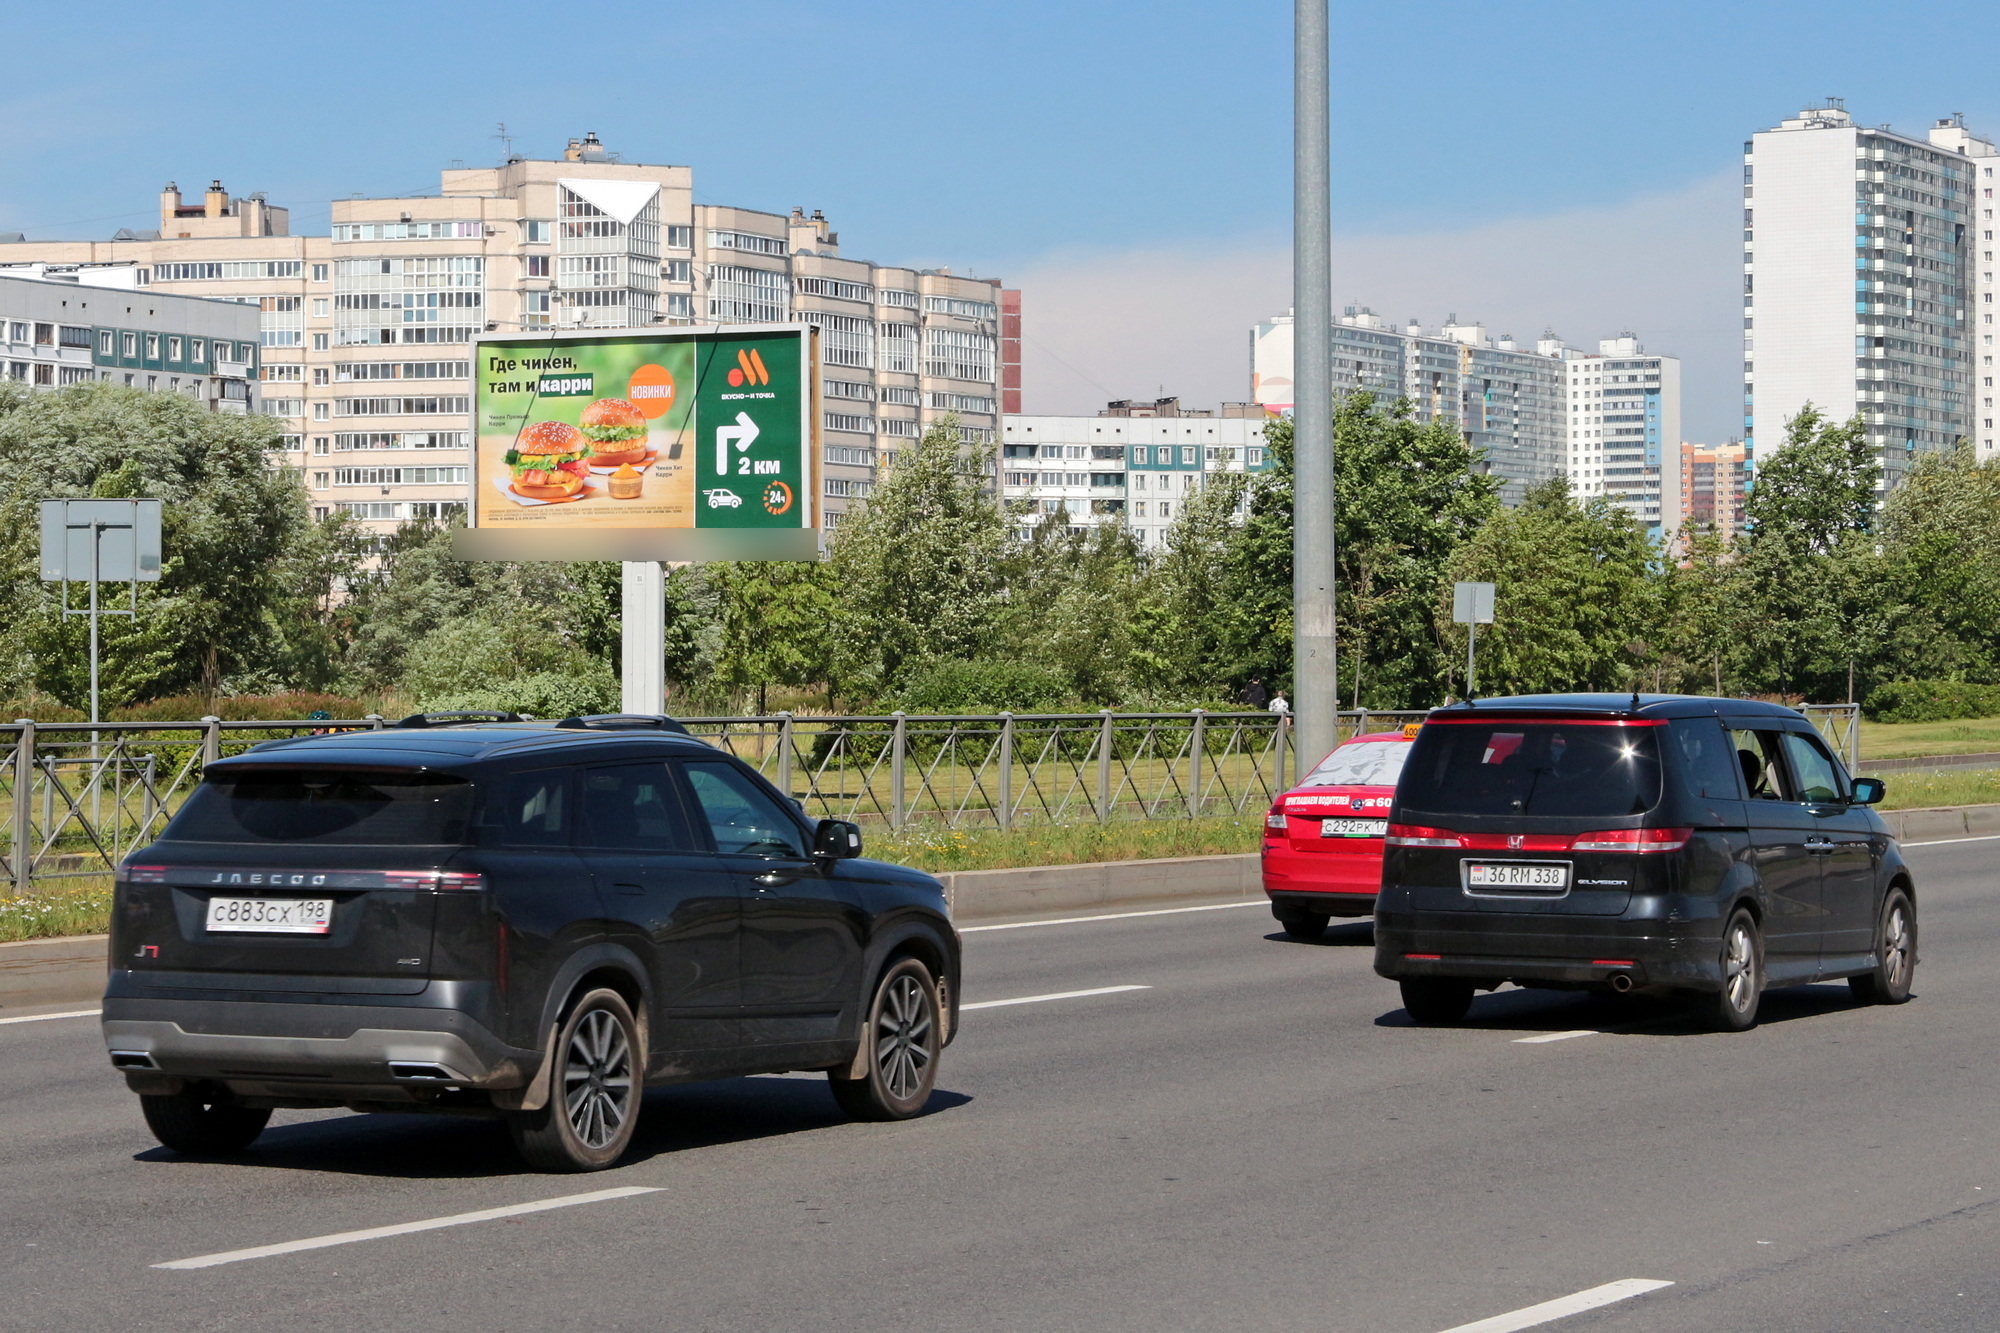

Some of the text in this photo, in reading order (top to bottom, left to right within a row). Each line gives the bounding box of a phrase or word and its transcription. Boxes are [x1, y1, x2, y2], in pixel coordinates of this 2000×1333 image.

[489, 357, 578, 374] Где чикен,
[488, 378, 592, 395] там и карри
[631, 385, 671, 399] НОВИНКИ
[738, 457, 750, 474] 2
[1310, 649, 1316, 658] 2
[1404, 727, 1421, 736] 600
[1318, 795, 1350, 806] ВОДИТЕЛЕЙ
[1489, 867, 1560, 884] 36 RM 338
